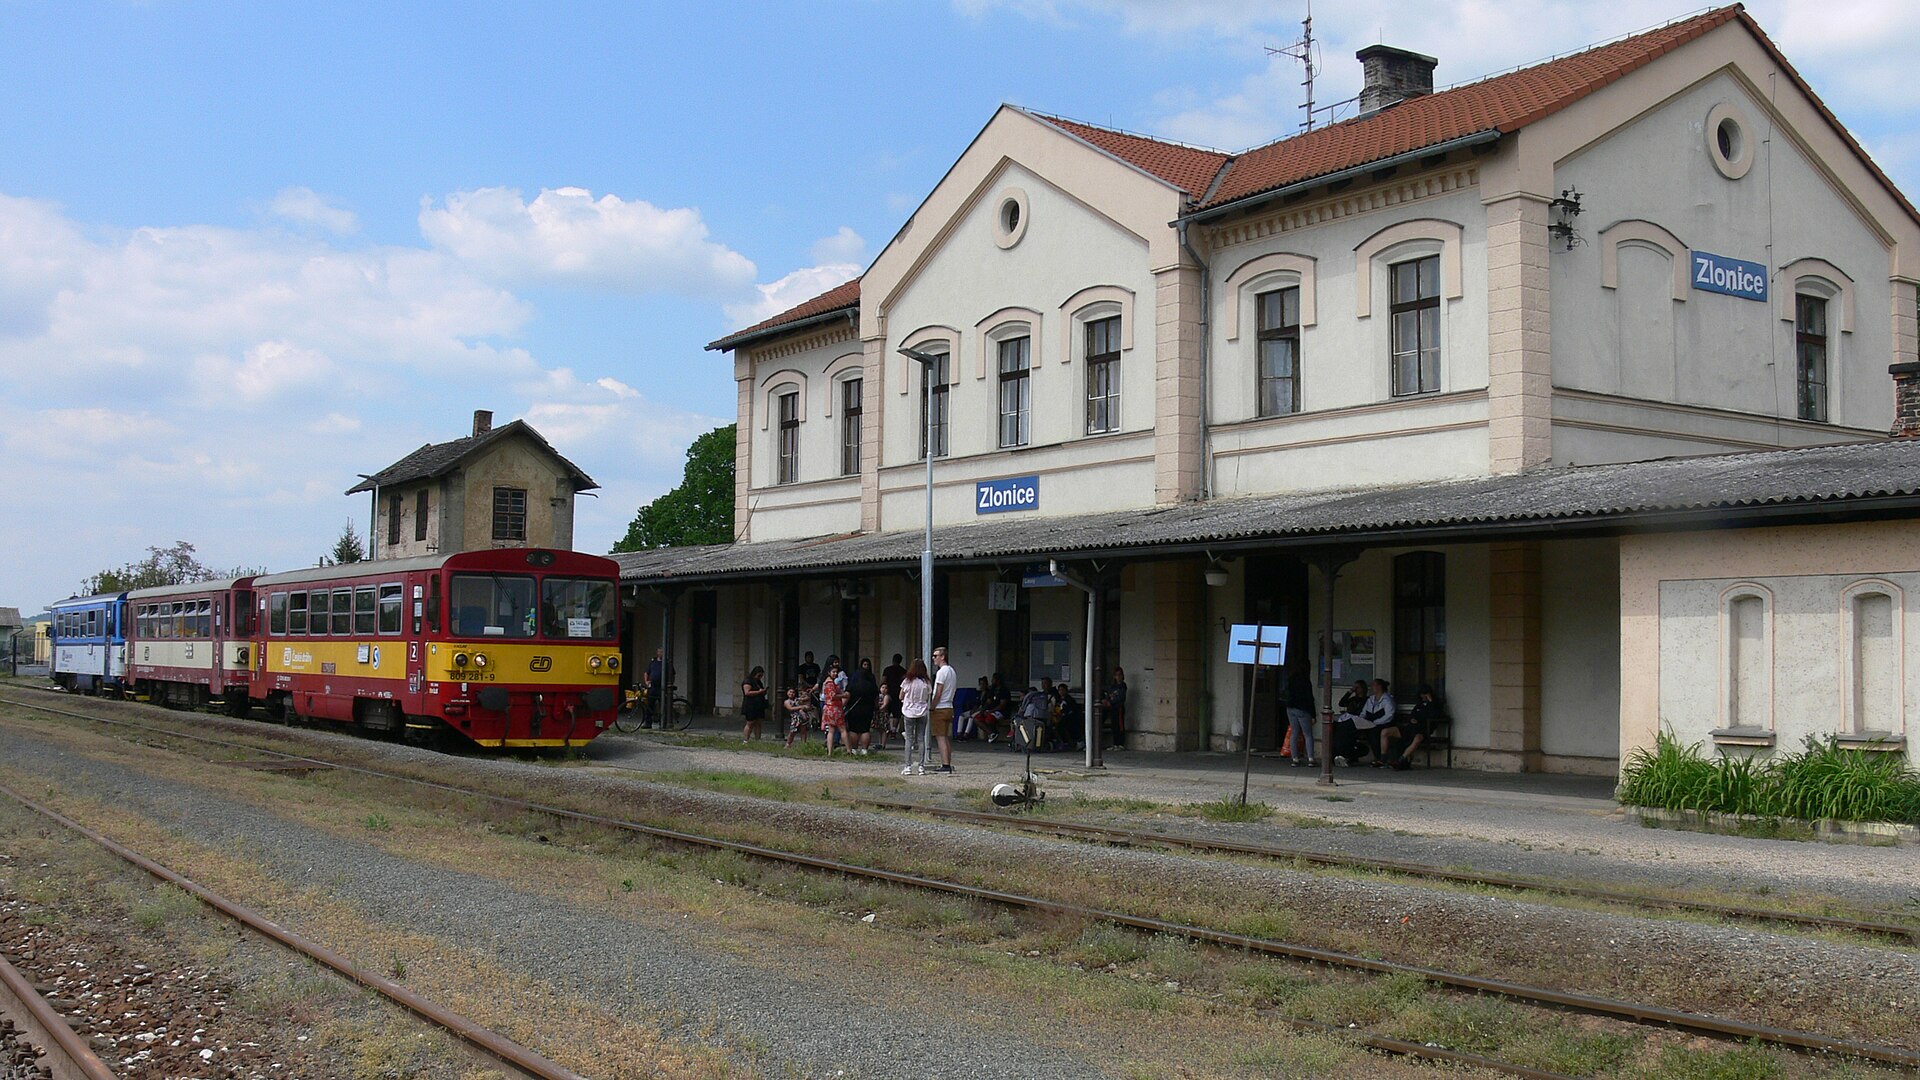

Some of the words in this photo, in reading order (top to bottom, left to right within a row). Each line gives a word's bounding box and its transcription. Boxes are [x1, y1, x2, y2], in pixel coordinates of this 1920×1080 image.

[1696, 257, 1764, 294] Zlonice
[979, 484, 1035, 508] Zlonice
[412, 645, 417, 658] 2
[450, 672, 466, 681] 809
[469, 674, 495, 682] 281-9
